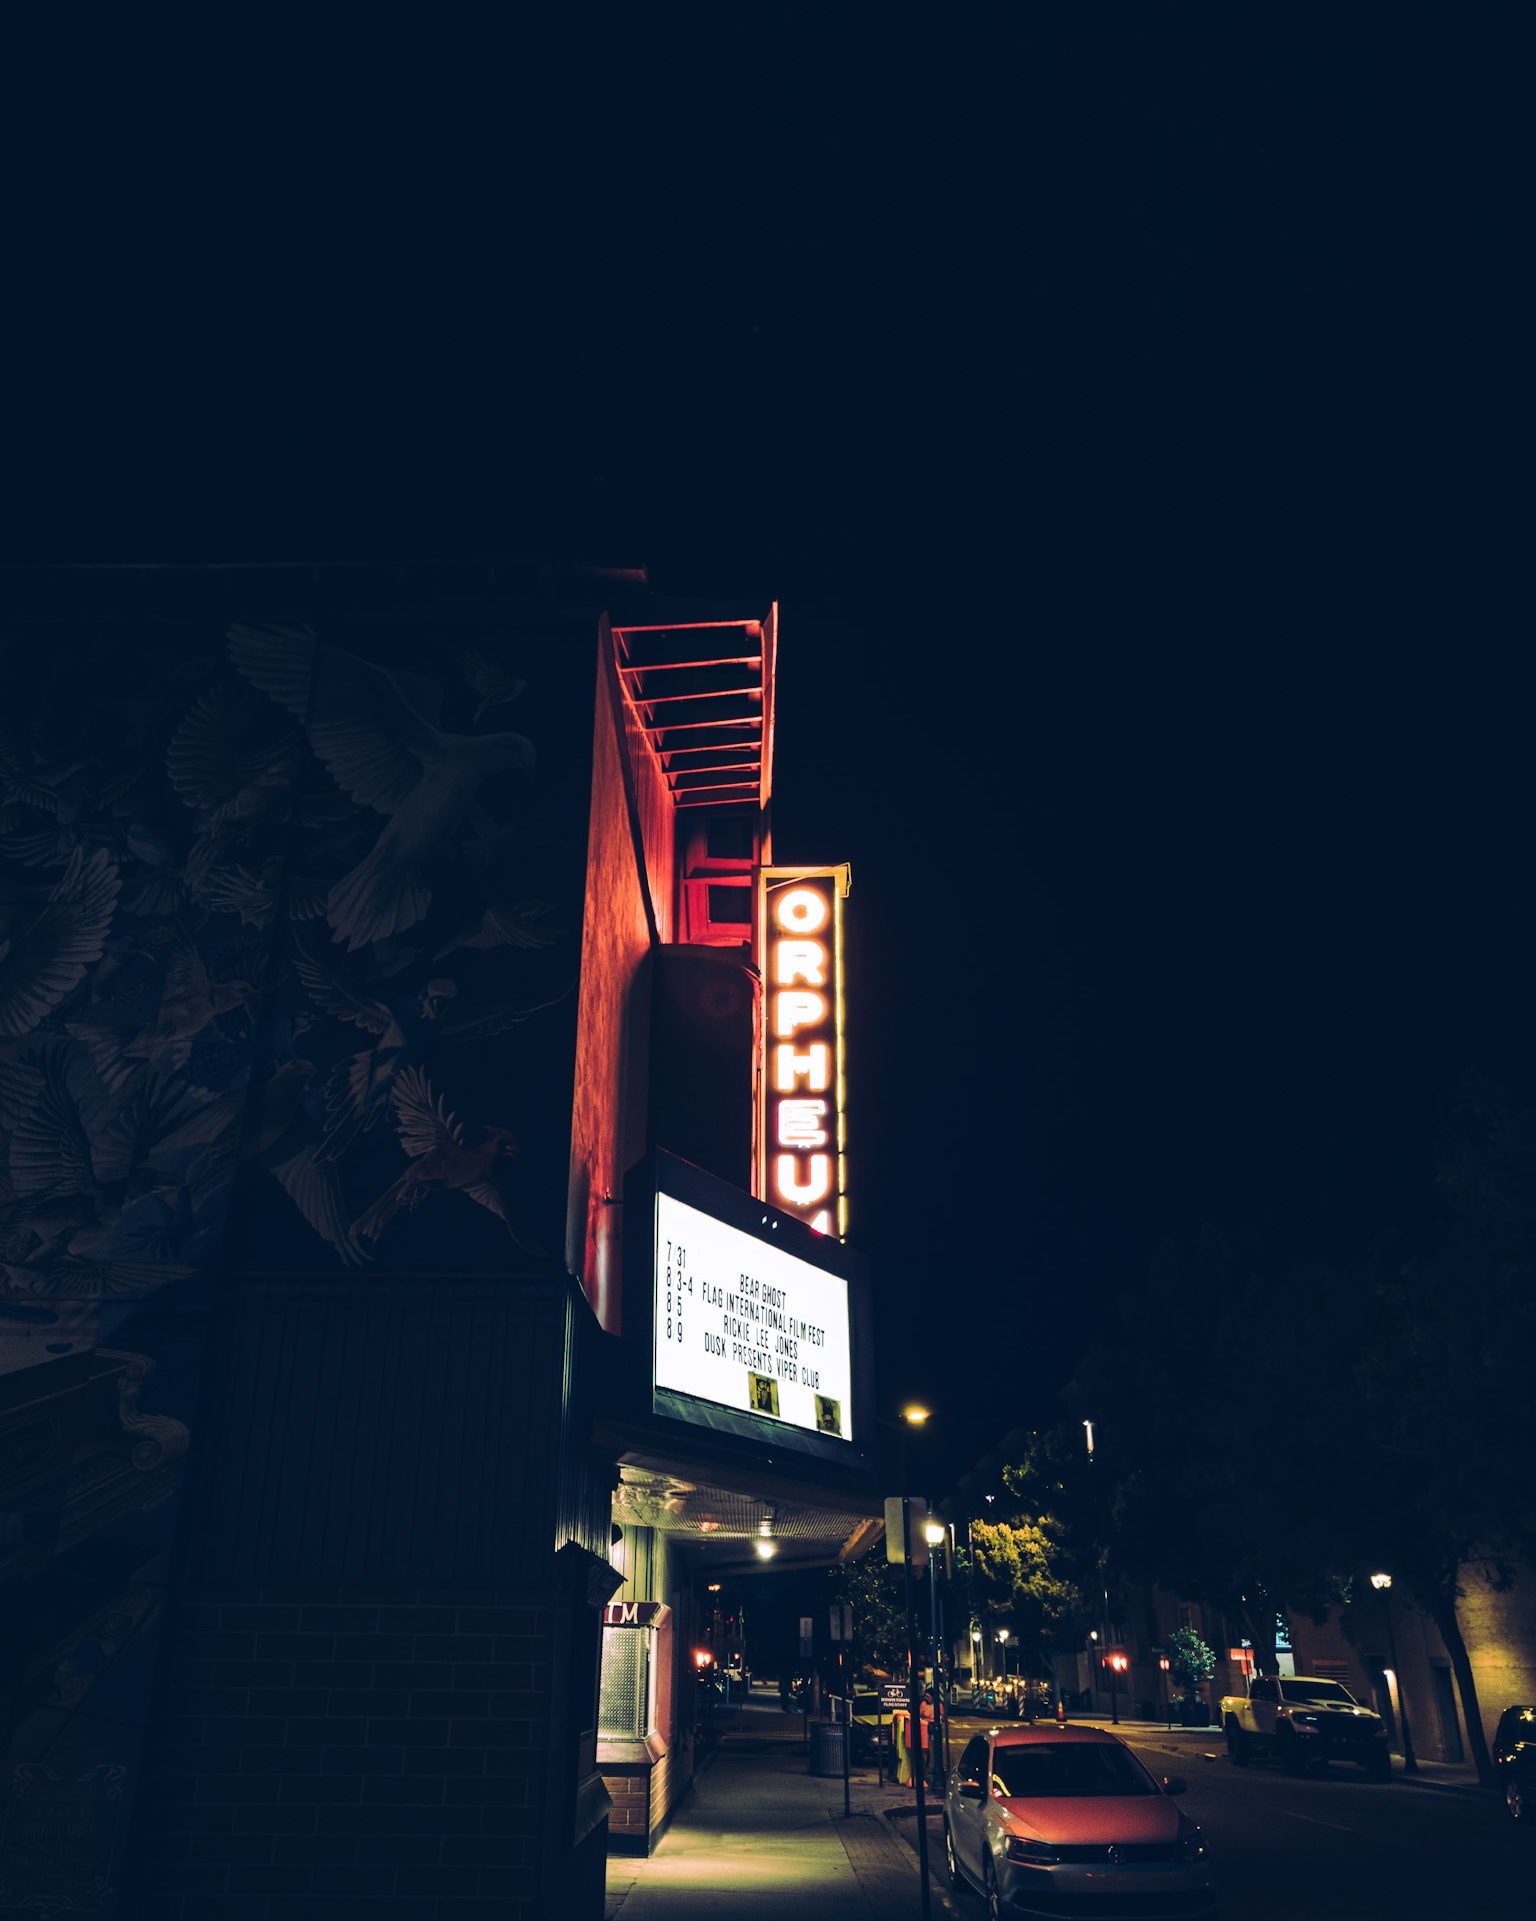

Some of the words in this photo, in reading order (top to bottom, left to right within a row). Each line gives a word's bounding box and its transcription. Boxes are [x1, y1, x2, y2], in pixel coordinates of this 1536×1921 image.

[703, 1282, 723, 1308] FLAG
[726, 1292, 787, 1333] INTERNATIONAL
[789, 1317, 806, 1341] FILM
[808, 1325, 825, 1347] FEST
[740, 1274, 759, 1299] BEAR
[762, 1284, 786, 1310] GHOST
[724, 1315, 750, 1342] RICKIE
[756, 1328, 769, 1349] LEE
[775, 1336, 798, 1360] JONES
[705, 1332, 727, 1358] DUSK
[733, 1342, 772, 1373] PRESENTS
[776, 1357, 797, 1383] VIPER
[802, 1367, 820, 1389] CLUB
[607, 1601, 639, 1624] TM
